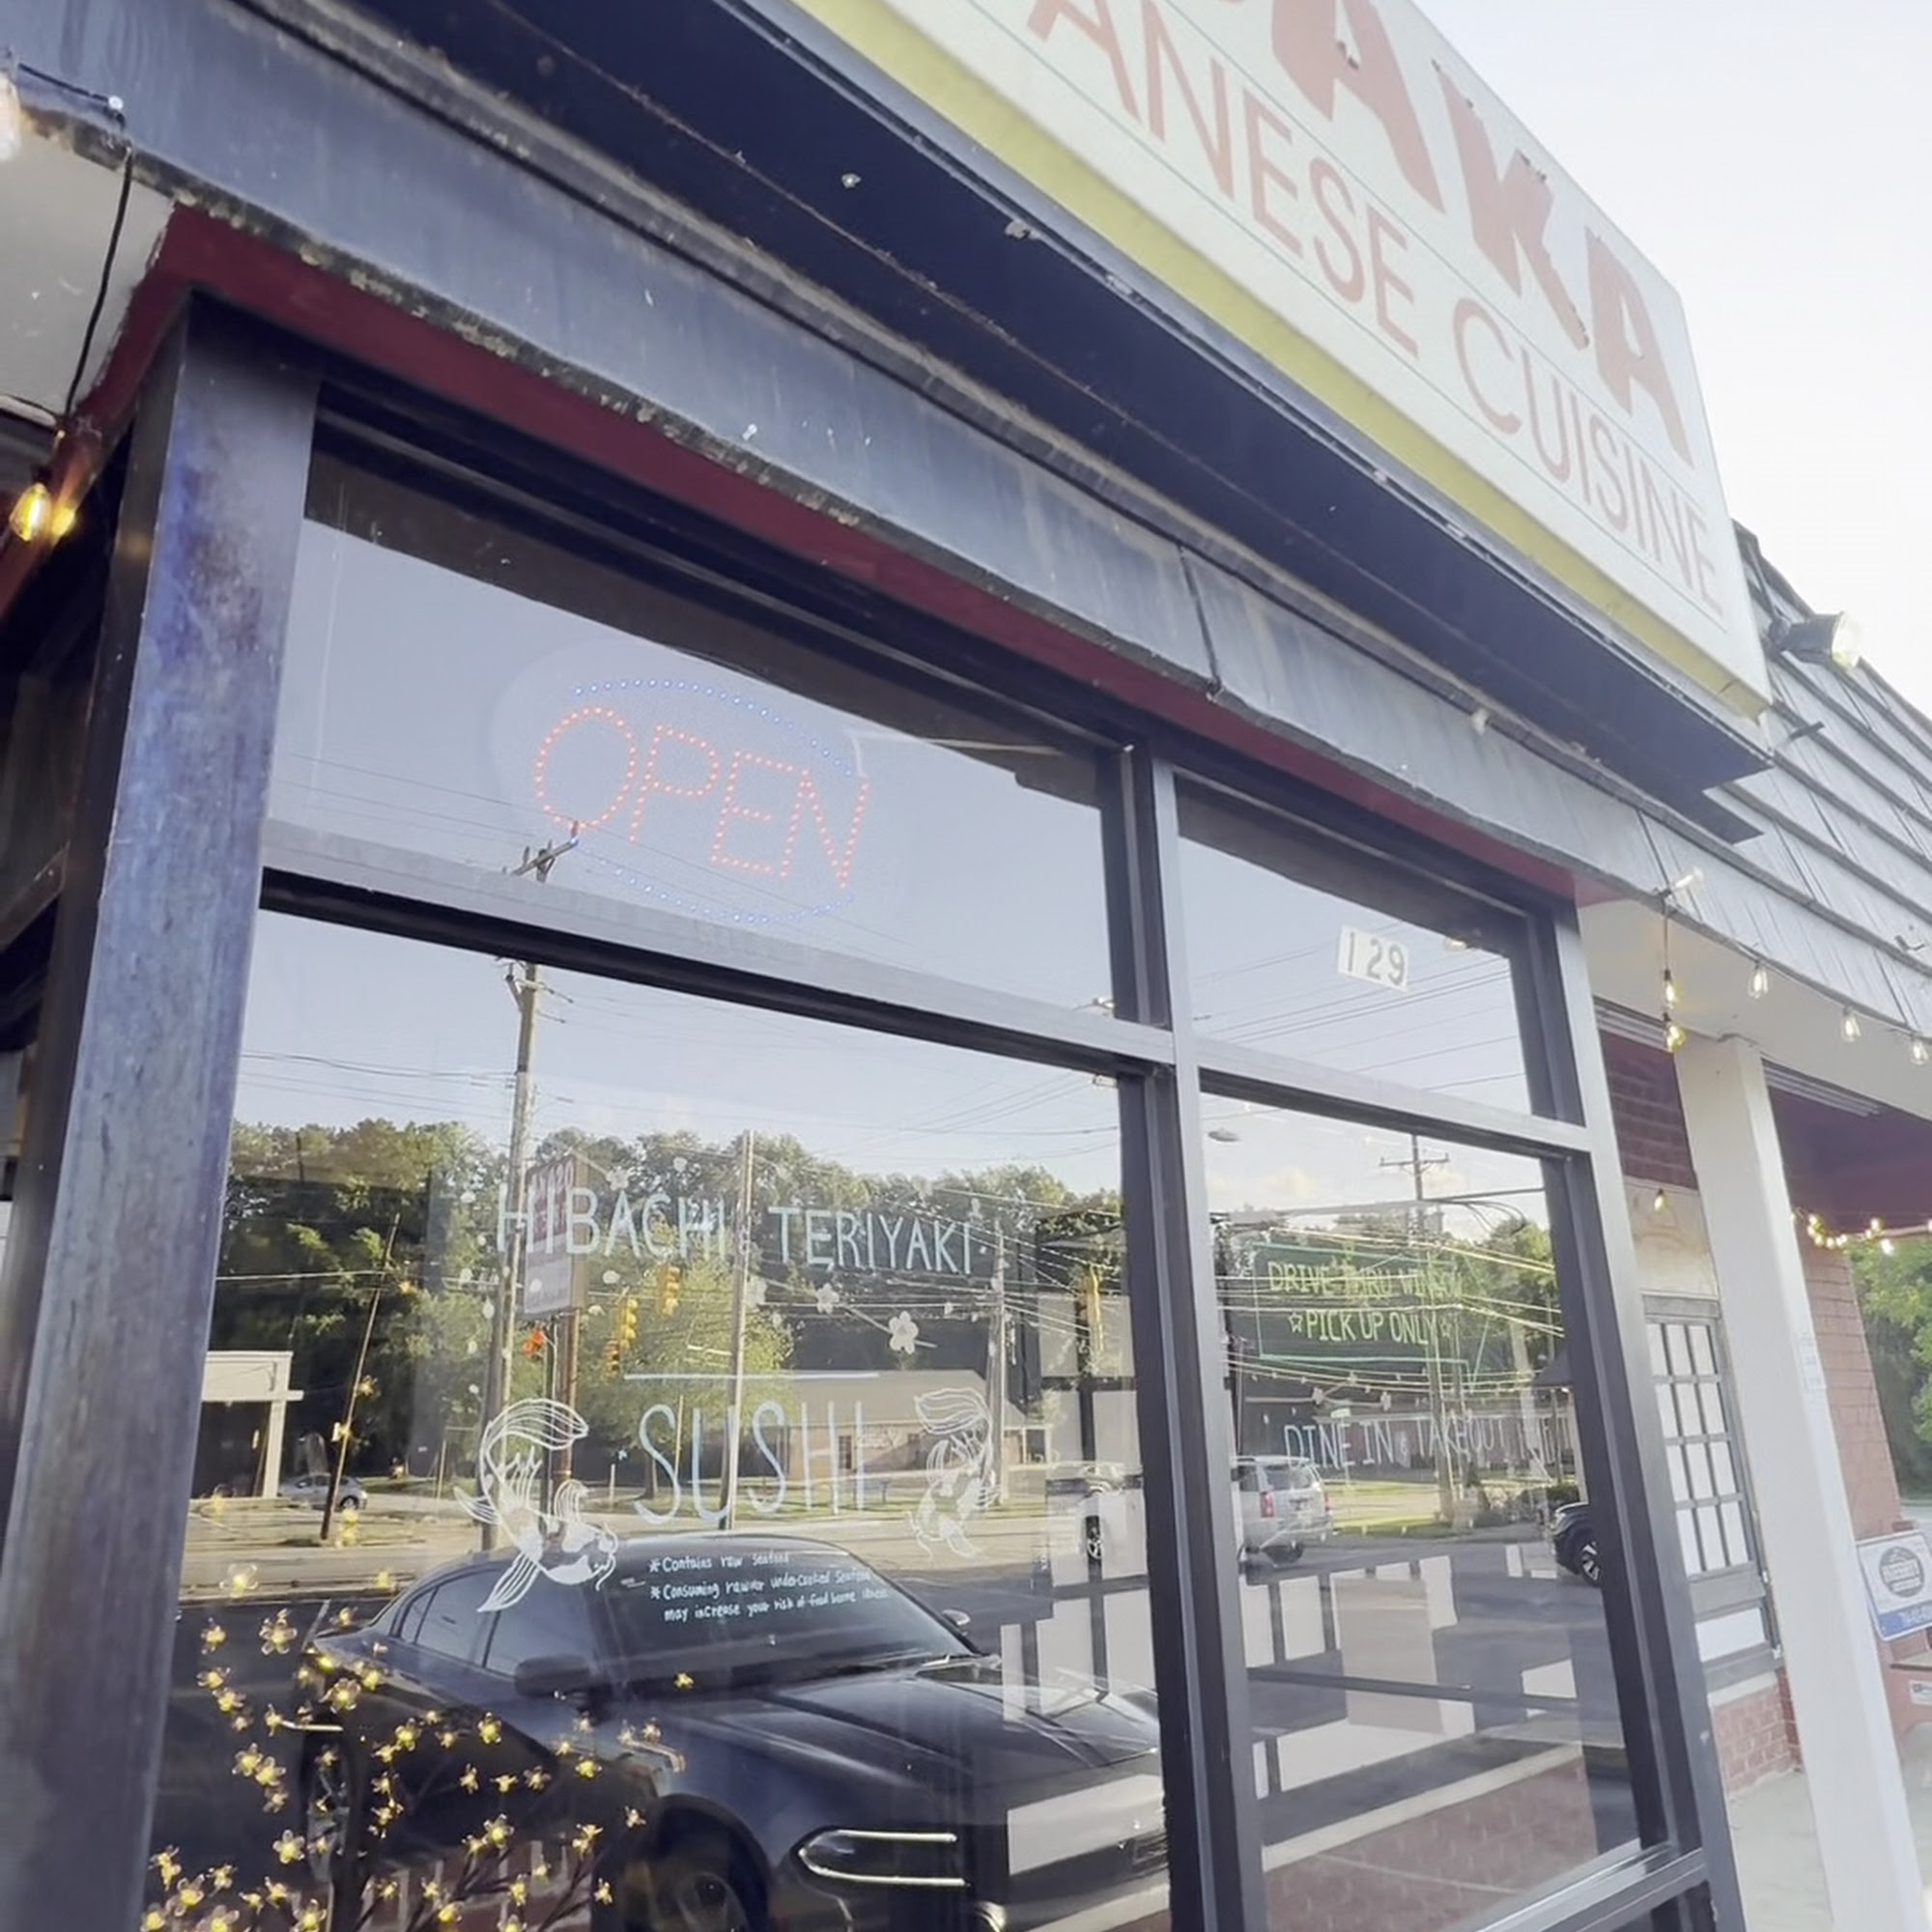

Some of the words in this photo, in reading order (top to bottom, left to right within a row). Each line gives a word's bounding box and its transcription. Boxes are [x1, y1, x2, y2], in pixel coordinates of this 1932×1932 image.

[1221, 0, 1695, 468] AKA
[1028, 0, 1419, 359] ANESE
[1452, 298, 1724, 615] CUISINE
[535, 706, 871, 890] OPEN
[1348, 931, 1406, 986] 129
[497, 1182, 726, 1260] HIBACHI
[768, 1207, 972, 1274] TERIYAKI
[1267, 1261, 1335, 1296] DRIVE
[1306, 1310, 1356, 1341] PICK
[1359, 1311, 1384, 1341] UP
[1390, 1312, 1436, 1346] ONLY
[634, 1400, 867, 1524] SUSHI
[1285, 1422, 1355, 1469] DINE
[1359, 1419, 1395, 1464] IN
[664, 1607, 689, 1623] may
[695, 1605, 741, 1618] increase
